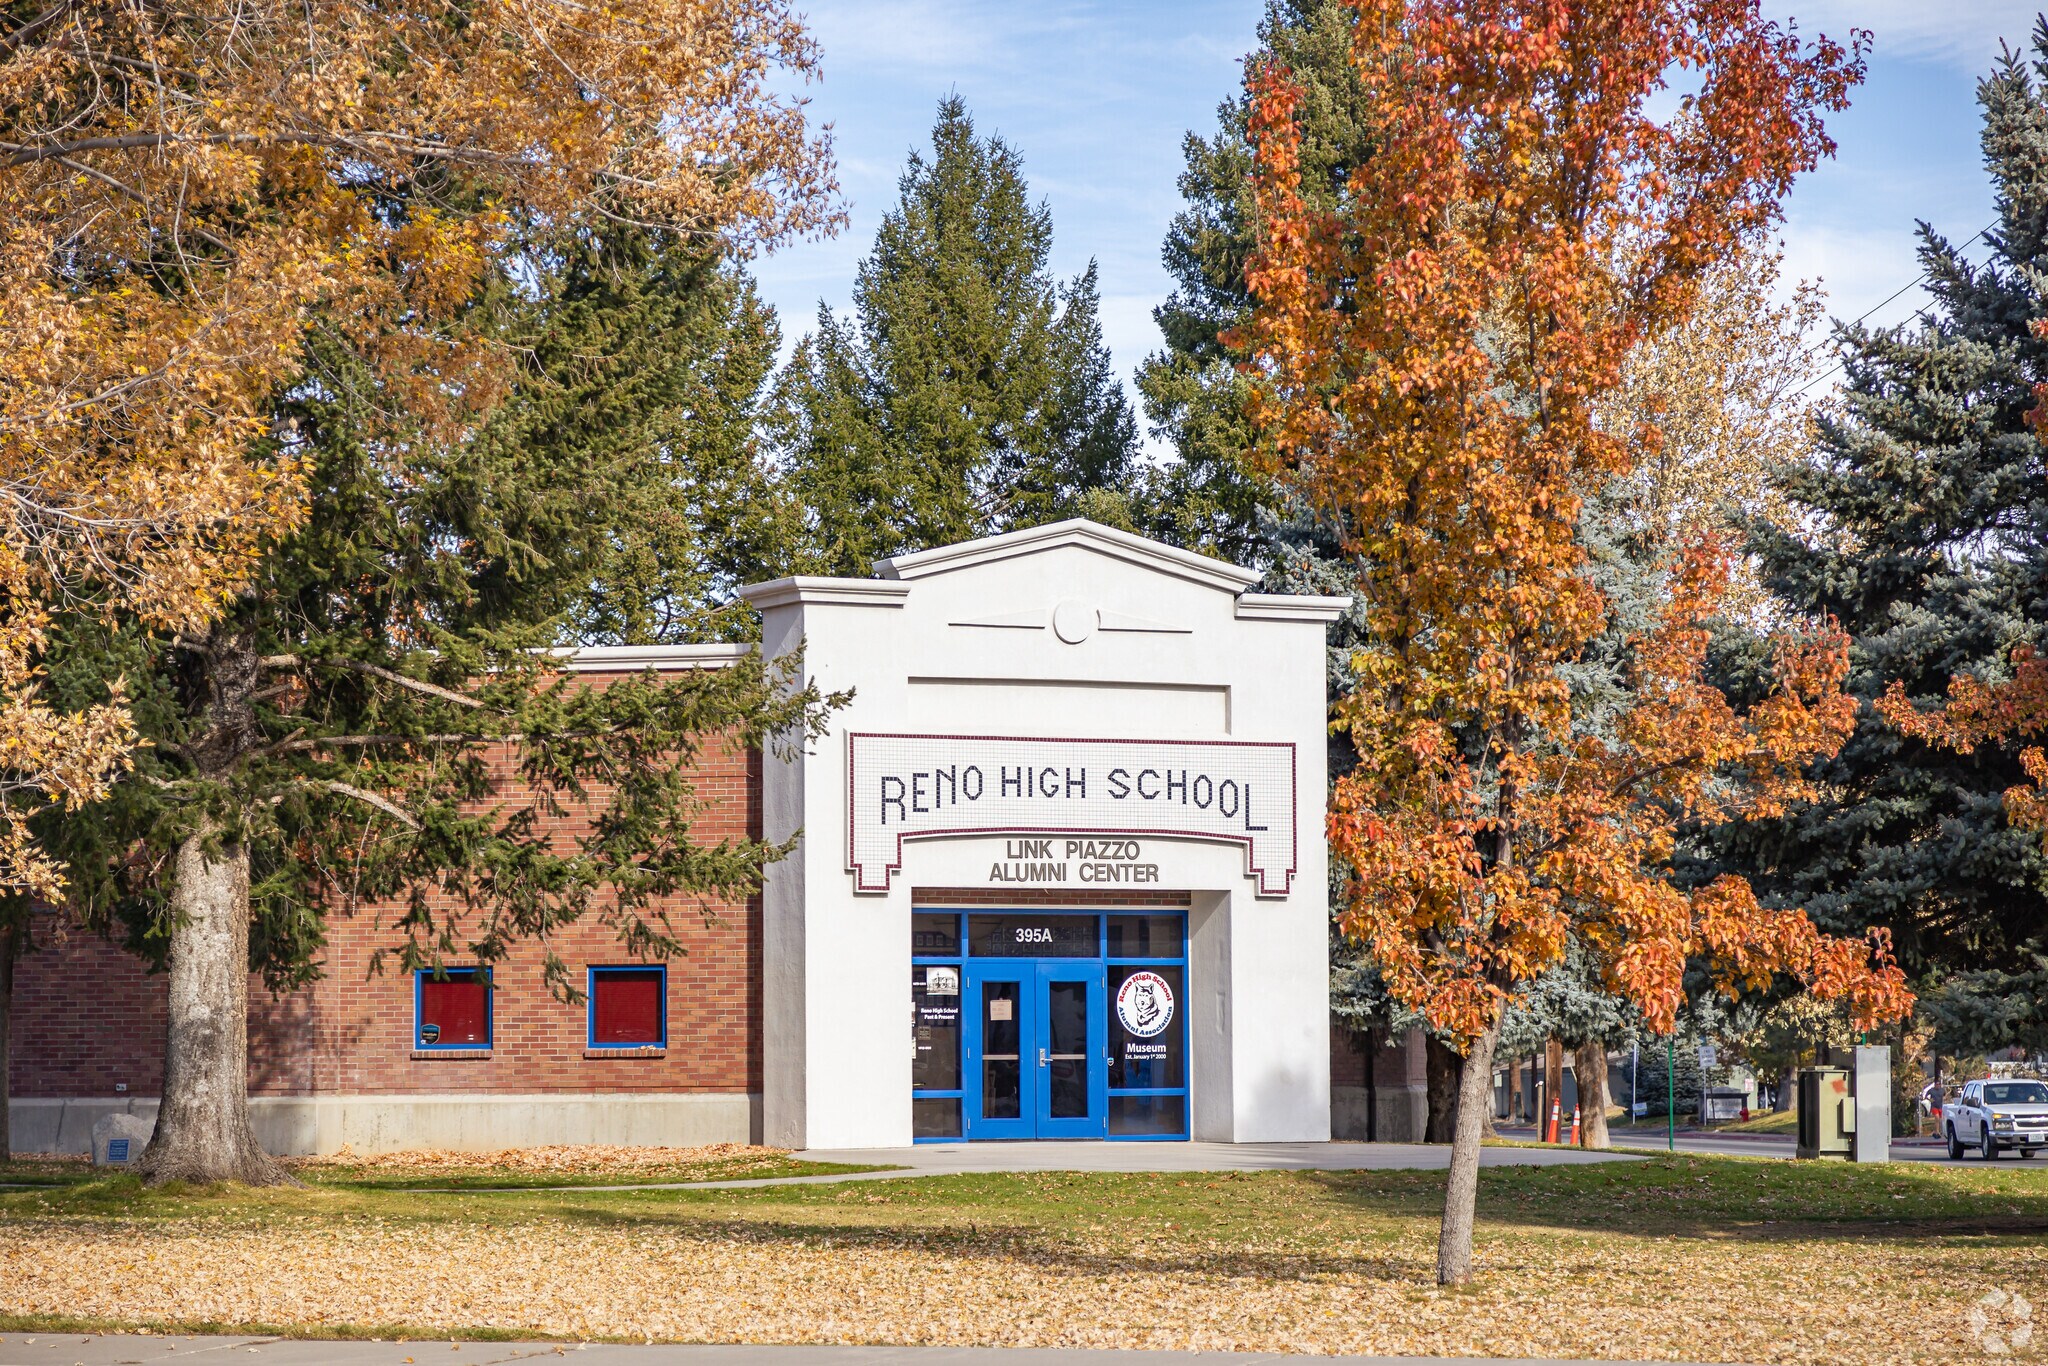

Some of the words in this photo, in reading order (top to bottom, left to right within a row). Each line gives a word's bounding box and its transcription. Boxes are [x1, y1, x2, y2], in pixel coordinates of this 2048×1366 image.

[881, 765, 983, 825] RENO
[1001, 766, 1086, 799] HIGH
[1107, 768, 1268, 831] SCHOOL
[1006, 840, 1054, 860] LINK
[1065, 840, 1141, 860] PIAZZO
[989, 863, 1067, 882] ALUMNI
[1079, 863, 1160, 883] CENTER
[1015, 928, 1053, 943] 395A
[1119, 980, 1133, 1003] Reno
[1132, 974, 1152, 983] High
[1152, 976, 1172, 1002] School
[1118, 1006, 1139, 1034] Alumni
[1139, 1006, 1172, 1035] Association
[1127, 1043, 1166, 1052] Museum
